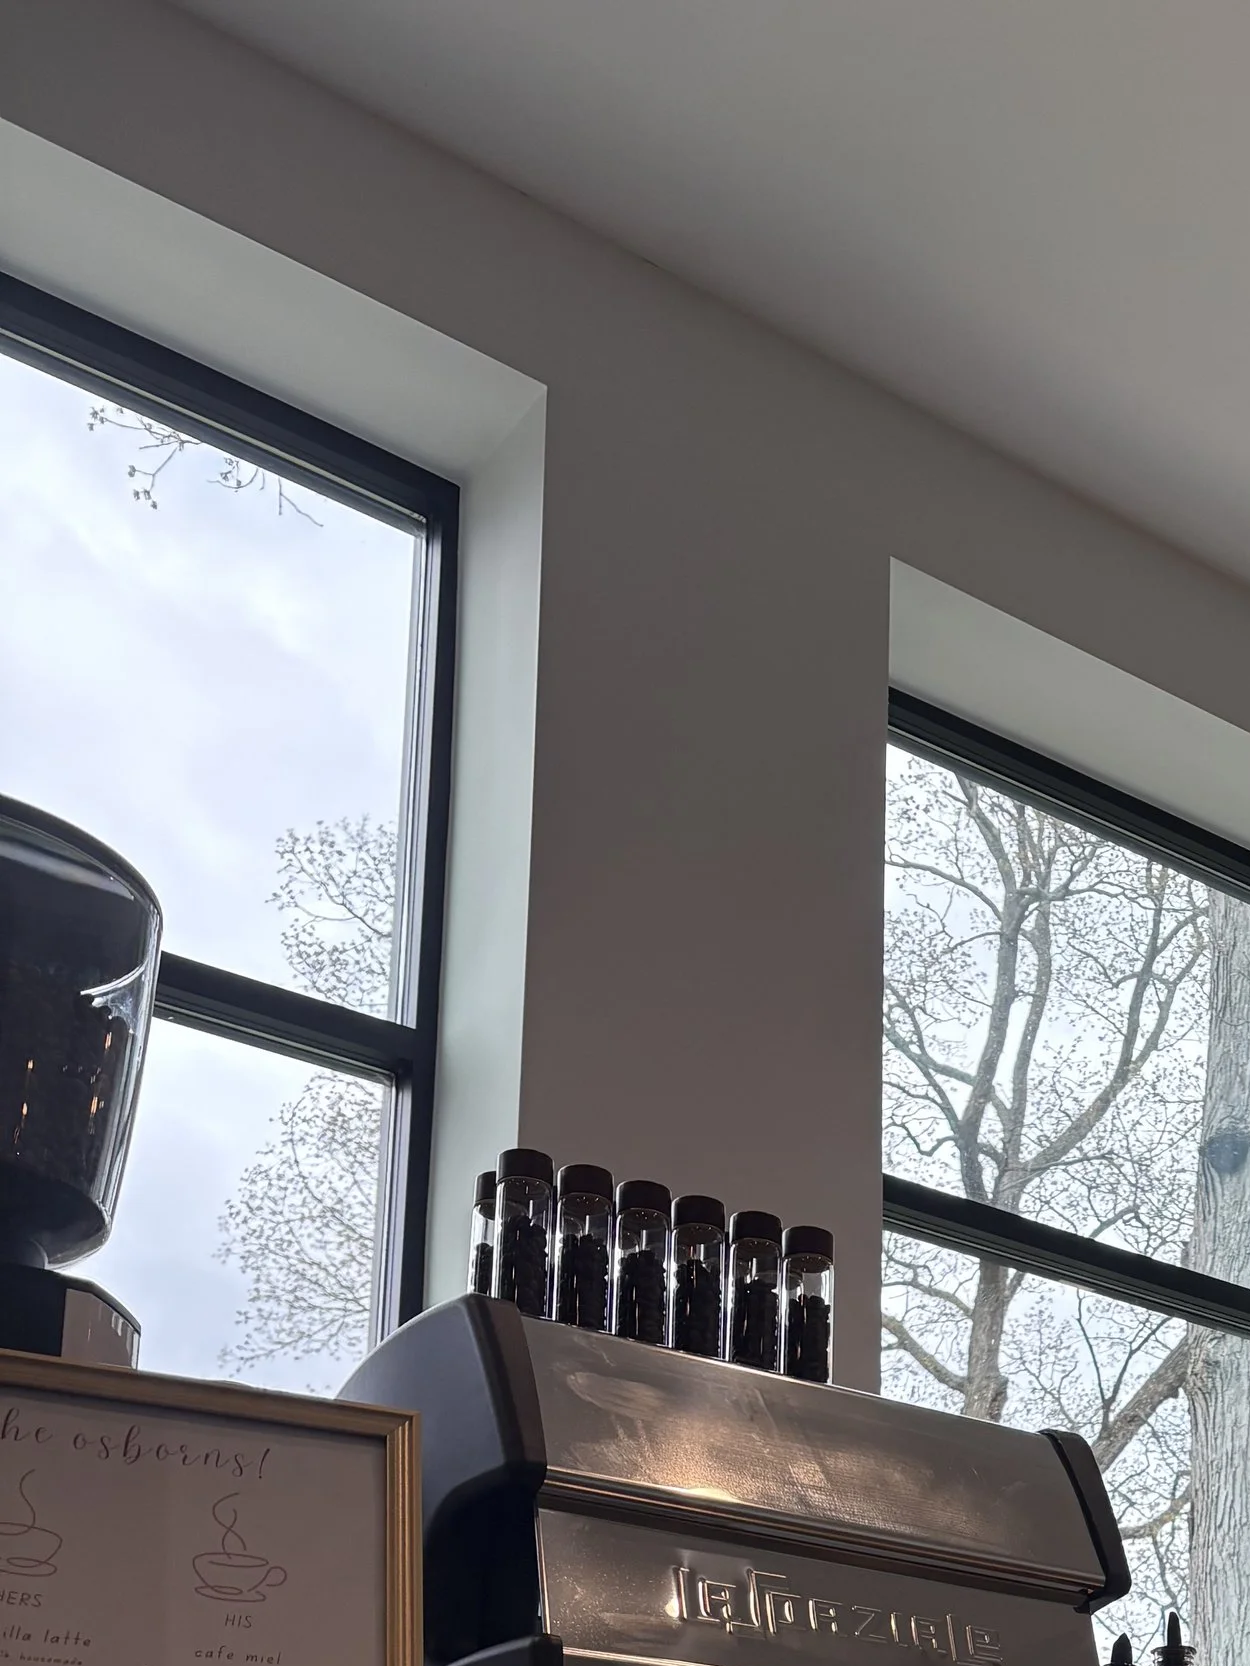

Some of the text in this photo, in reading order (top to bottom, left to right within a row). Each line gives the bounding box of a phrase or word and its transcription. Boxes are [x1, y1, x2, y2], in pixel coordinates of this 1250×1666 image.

[73, 1425, 270, 1479] osborns!
[225, 1613, 252, 1629] HIS
[43, 1629, 91, 1647] latte
[194, 1645, 281, 1665] cafe miel
